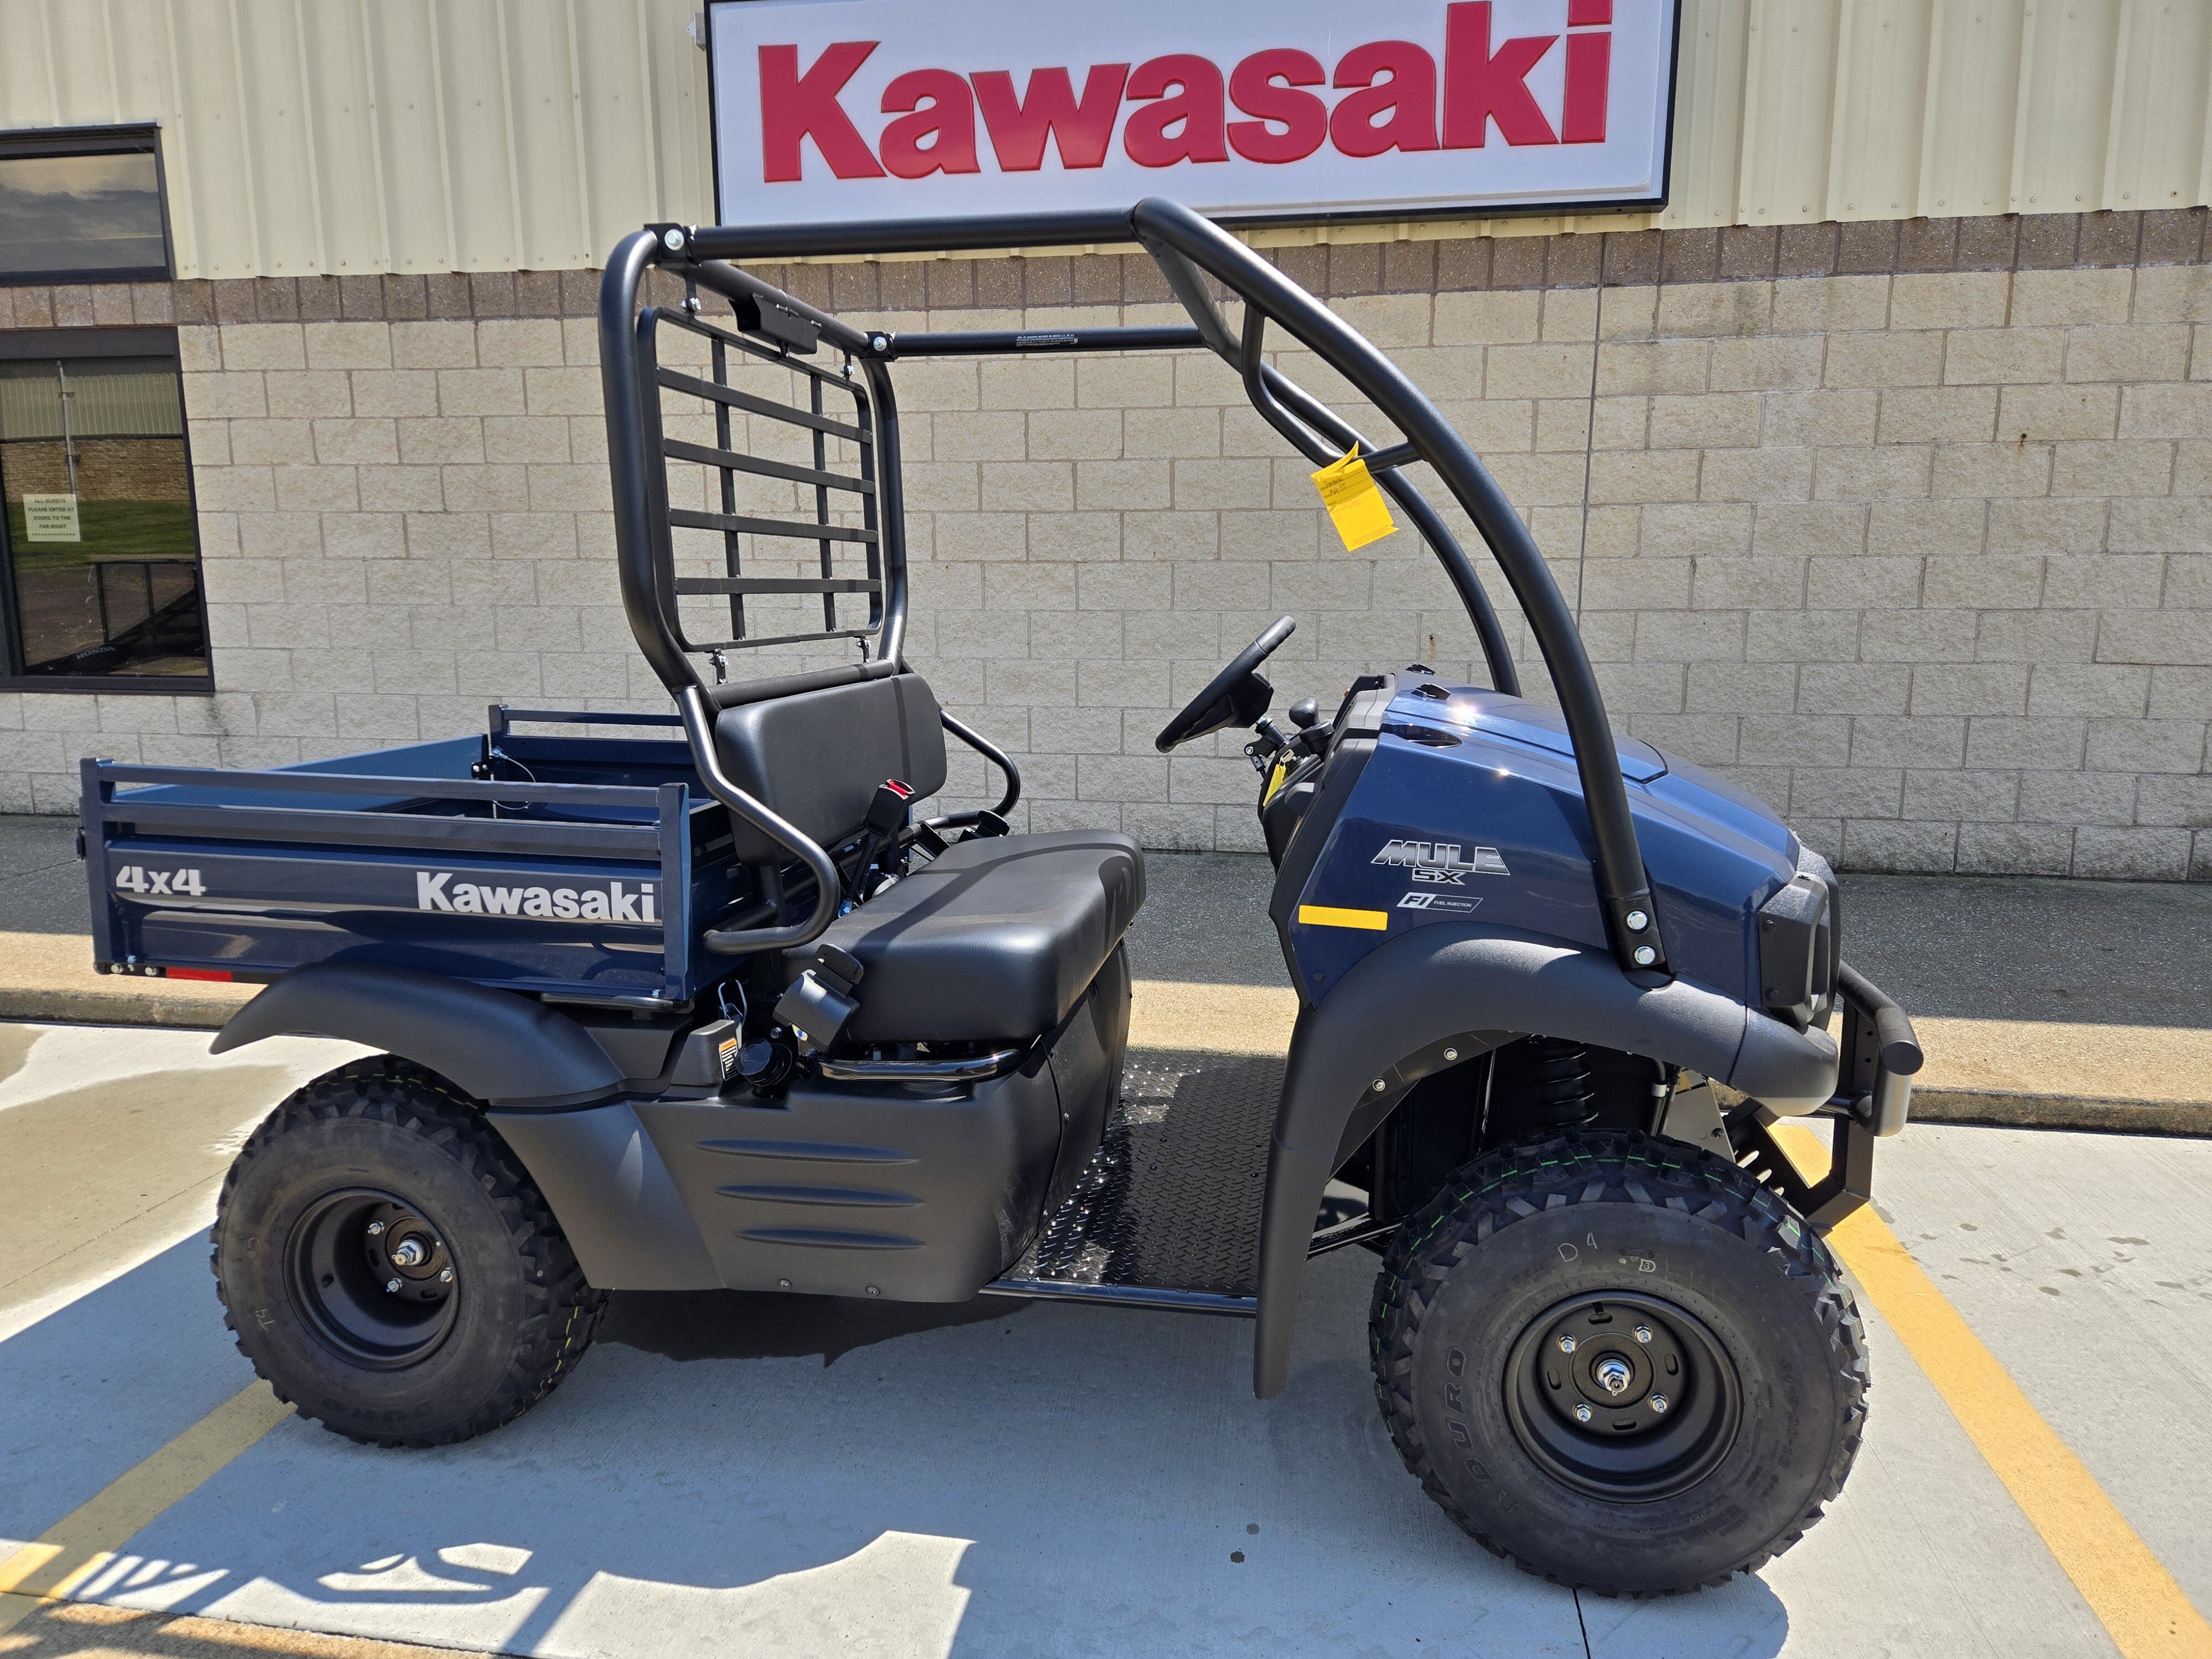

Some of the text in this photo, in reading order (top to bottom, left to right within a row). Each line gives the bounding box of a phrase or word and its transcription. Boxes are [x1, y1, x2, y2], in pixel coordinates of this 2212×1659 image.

[758, 0, 1613, 183] Kawasaki
[76, 646, 116, 660] HONDA
[1370, 839, 1511, 875] MULE
[116, 865, 207, 896] 4x4
[1412, 868, 1466, 885] SX
[416, 872, 655, 922] Kawasaki
[1402, 895, 1432, 906] FI
[1444, 1347, 1494, 1481] DURO
